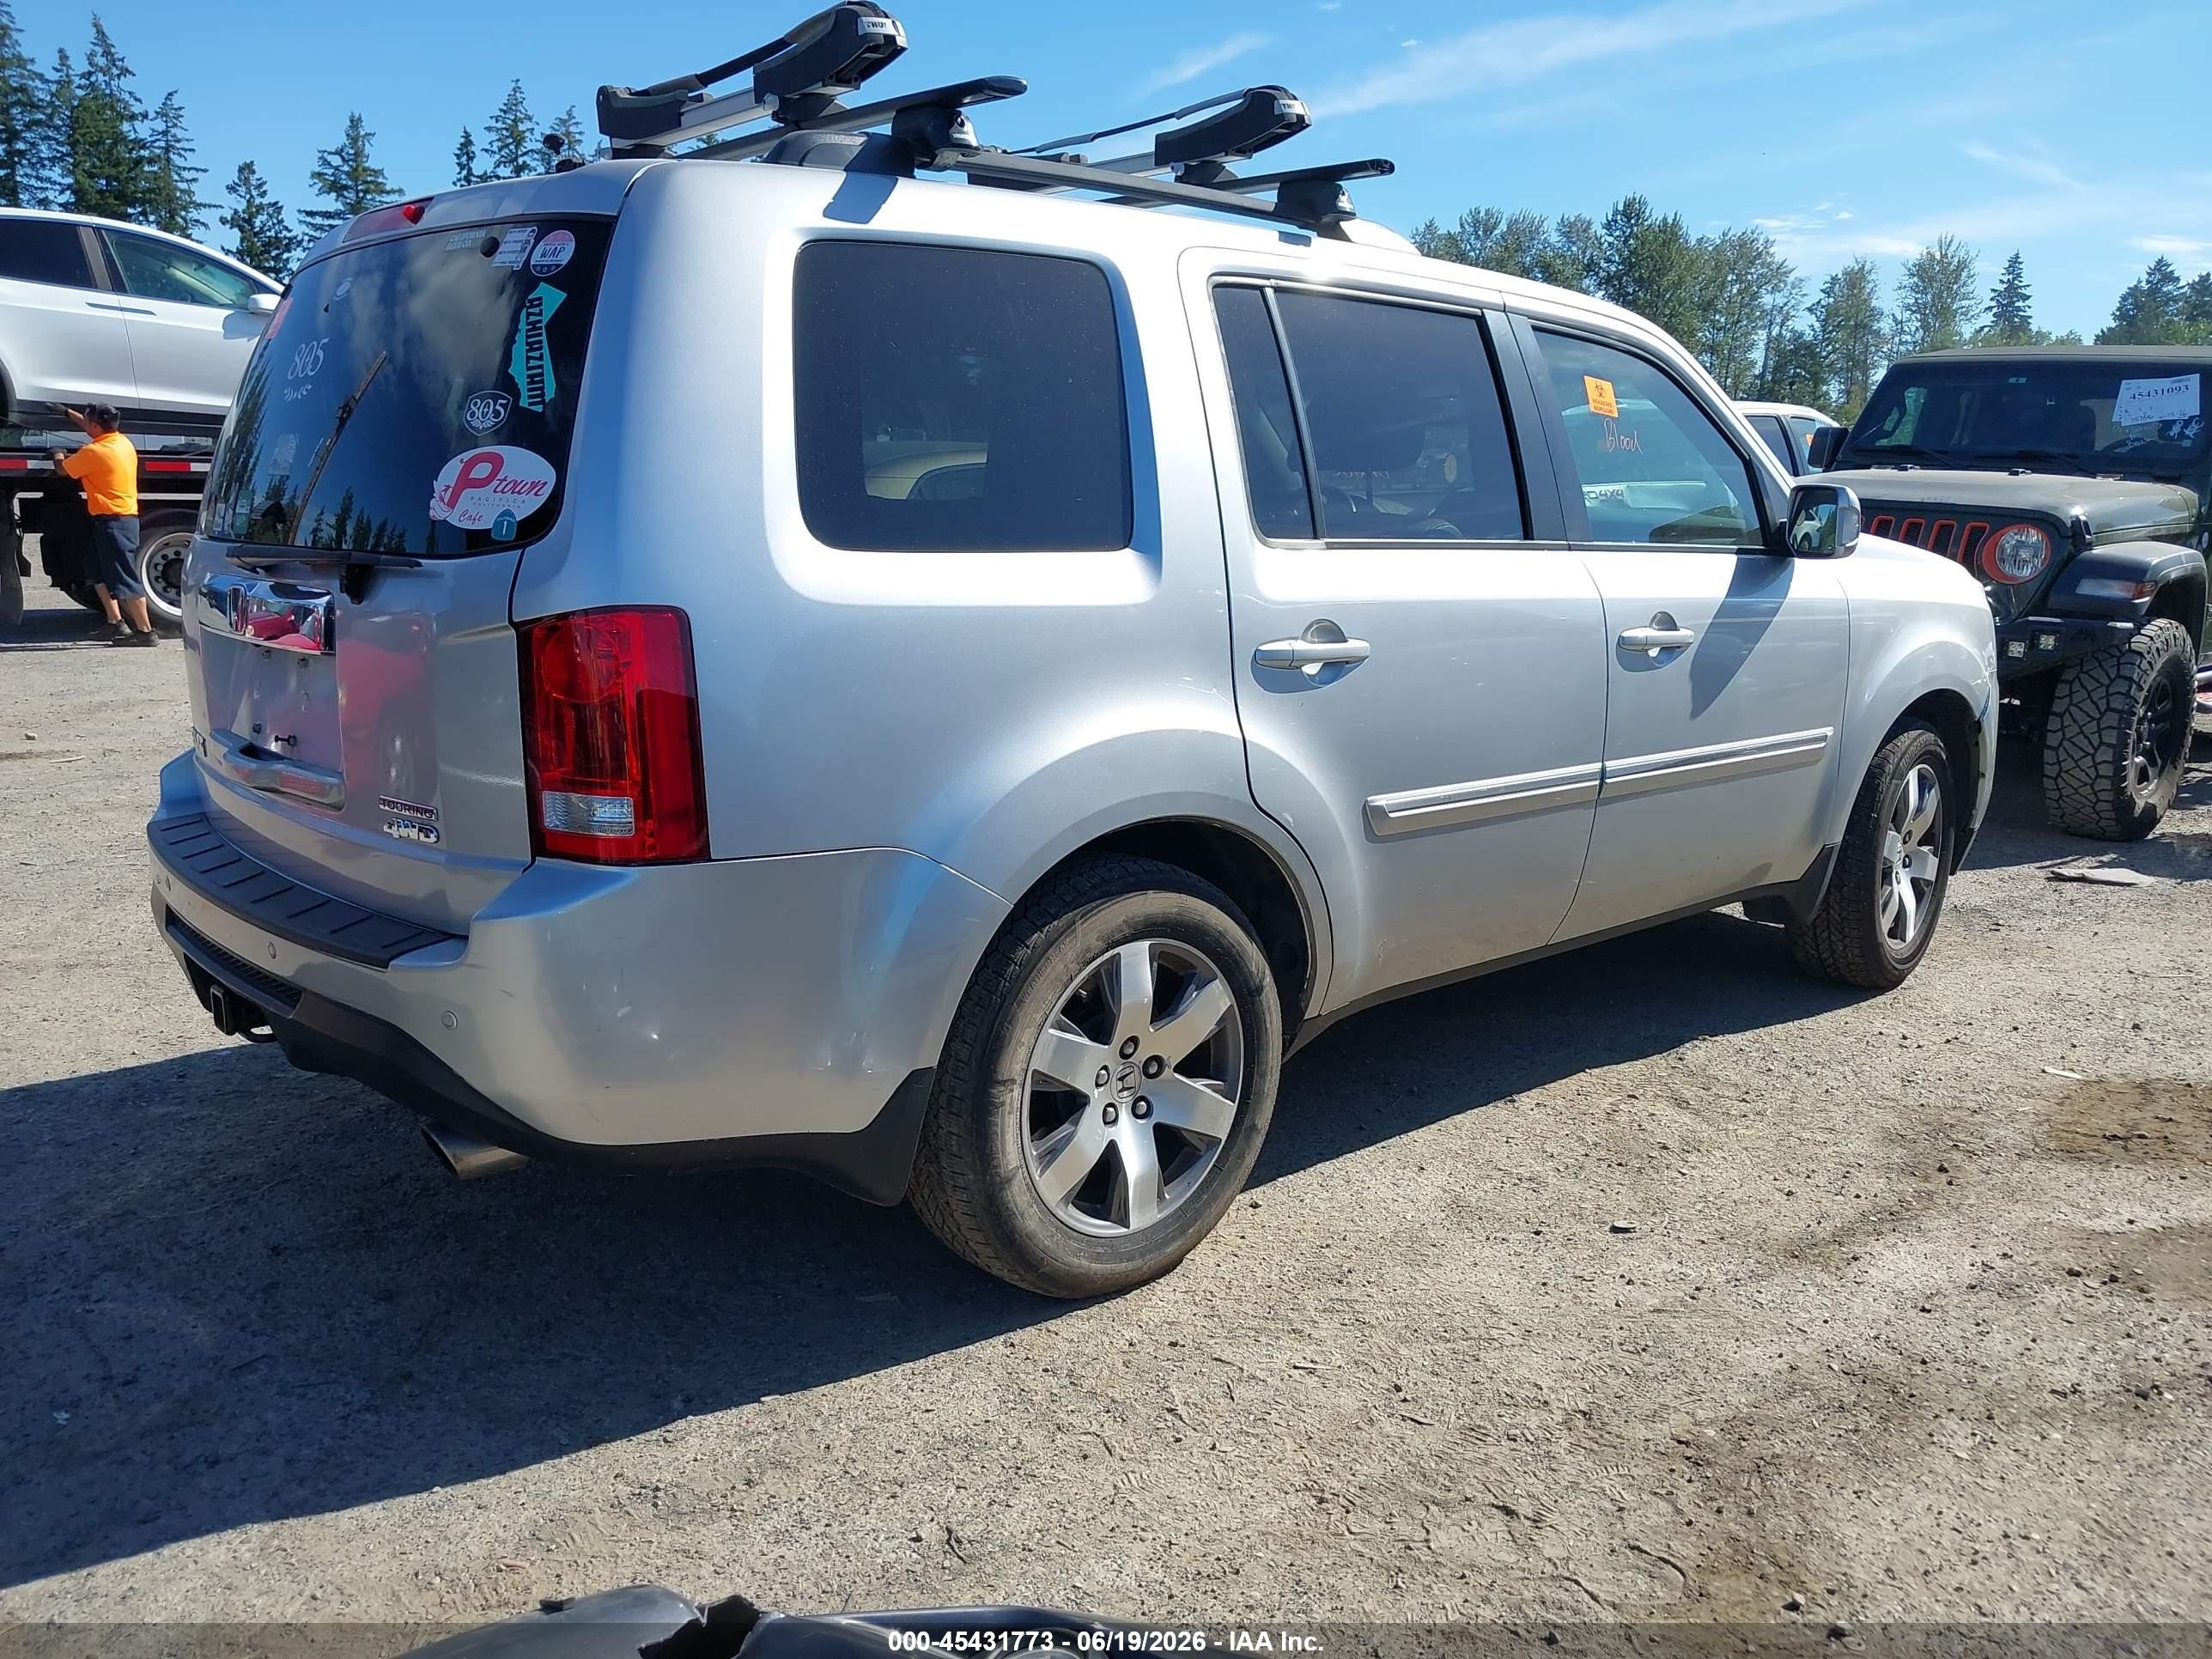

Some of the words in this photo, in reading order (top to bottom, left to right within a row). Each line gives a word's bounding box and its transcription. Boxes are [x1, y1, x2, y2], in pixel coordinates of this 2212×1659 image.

[540, 246, 566, 259] WAP
[288, 337, 330, 380] 805
[2130, 384, 2190, 400] 45431093
[466, 398, 507, 422] 805
[1604, 417, 1644, 454] Blood
[471, 495, 526, 504] PACIFICA
[458, 508, 483, 526] Cafe
[502, 520, 507, 536] 1
[379, 799, 434, 818] TOURING
[383, 817, 440, 843] 4WD
